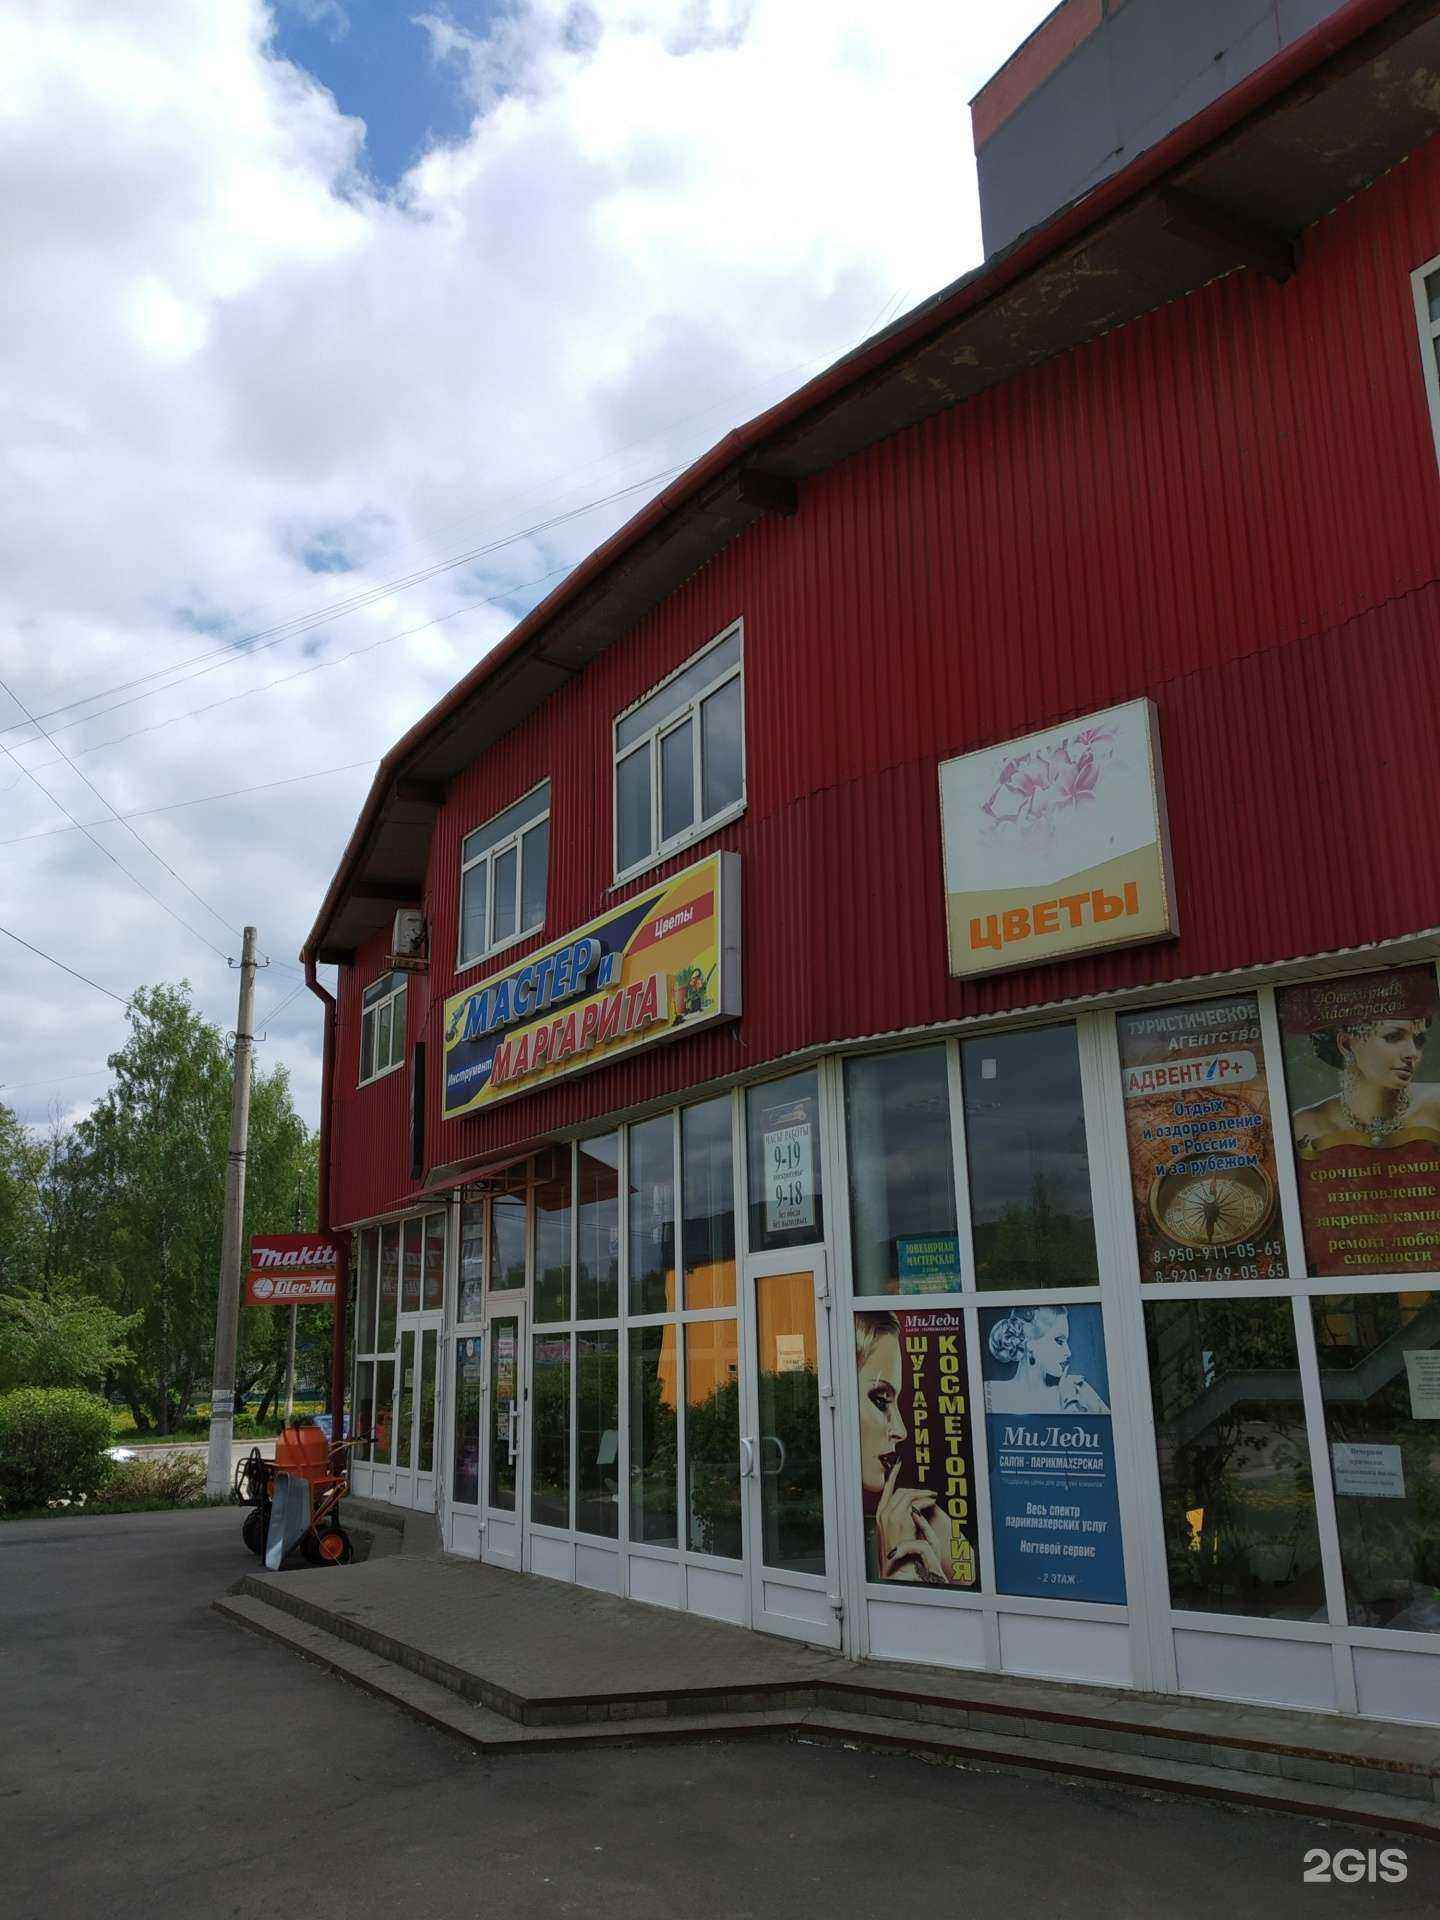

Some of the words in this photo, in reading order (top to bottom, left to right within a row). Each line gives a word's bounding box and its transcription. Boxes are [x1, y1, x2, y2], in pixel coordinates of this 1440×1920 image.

[655, 907, 694, 938] Цветы
[969, 881, 1139, 951] ЦВЕТЫ
[462, 938, 600, 1042] МАСТЕР
[489, 972, 667, 1088] МАРГАРИТА
[1128, 1004, 1259, 1036] ТУРИСТИЧЕСКОЕ
[1167, 1027, 1260, 1050] АГЕНТСТВО
[1173, 1098, 1225, 1117] Отдых
[1155, 1115, 1264, 1139] оздоровление
[774, 1141, 801, 1173] 9-19
[1183, 1138, 1238, 1154] России
[1189, 1155, 1259, 1178] рубежом
[1310, 1162, 1383, 1183] срочный
[1387, 1160, 1440, 1178] ремон
[775, 1181, 803, 1208] 9-18
[1327, 1185, 1437, 1204] изготовление
[1391, 1210, 1440, 1225] камне
[906, 1336, 932, 1483] ШУГАРИНГ
[938, 1334, 974, 1582] КОСМЕТОЛОГИЯ
[1026, 1502, 1047, 1515] Весь
